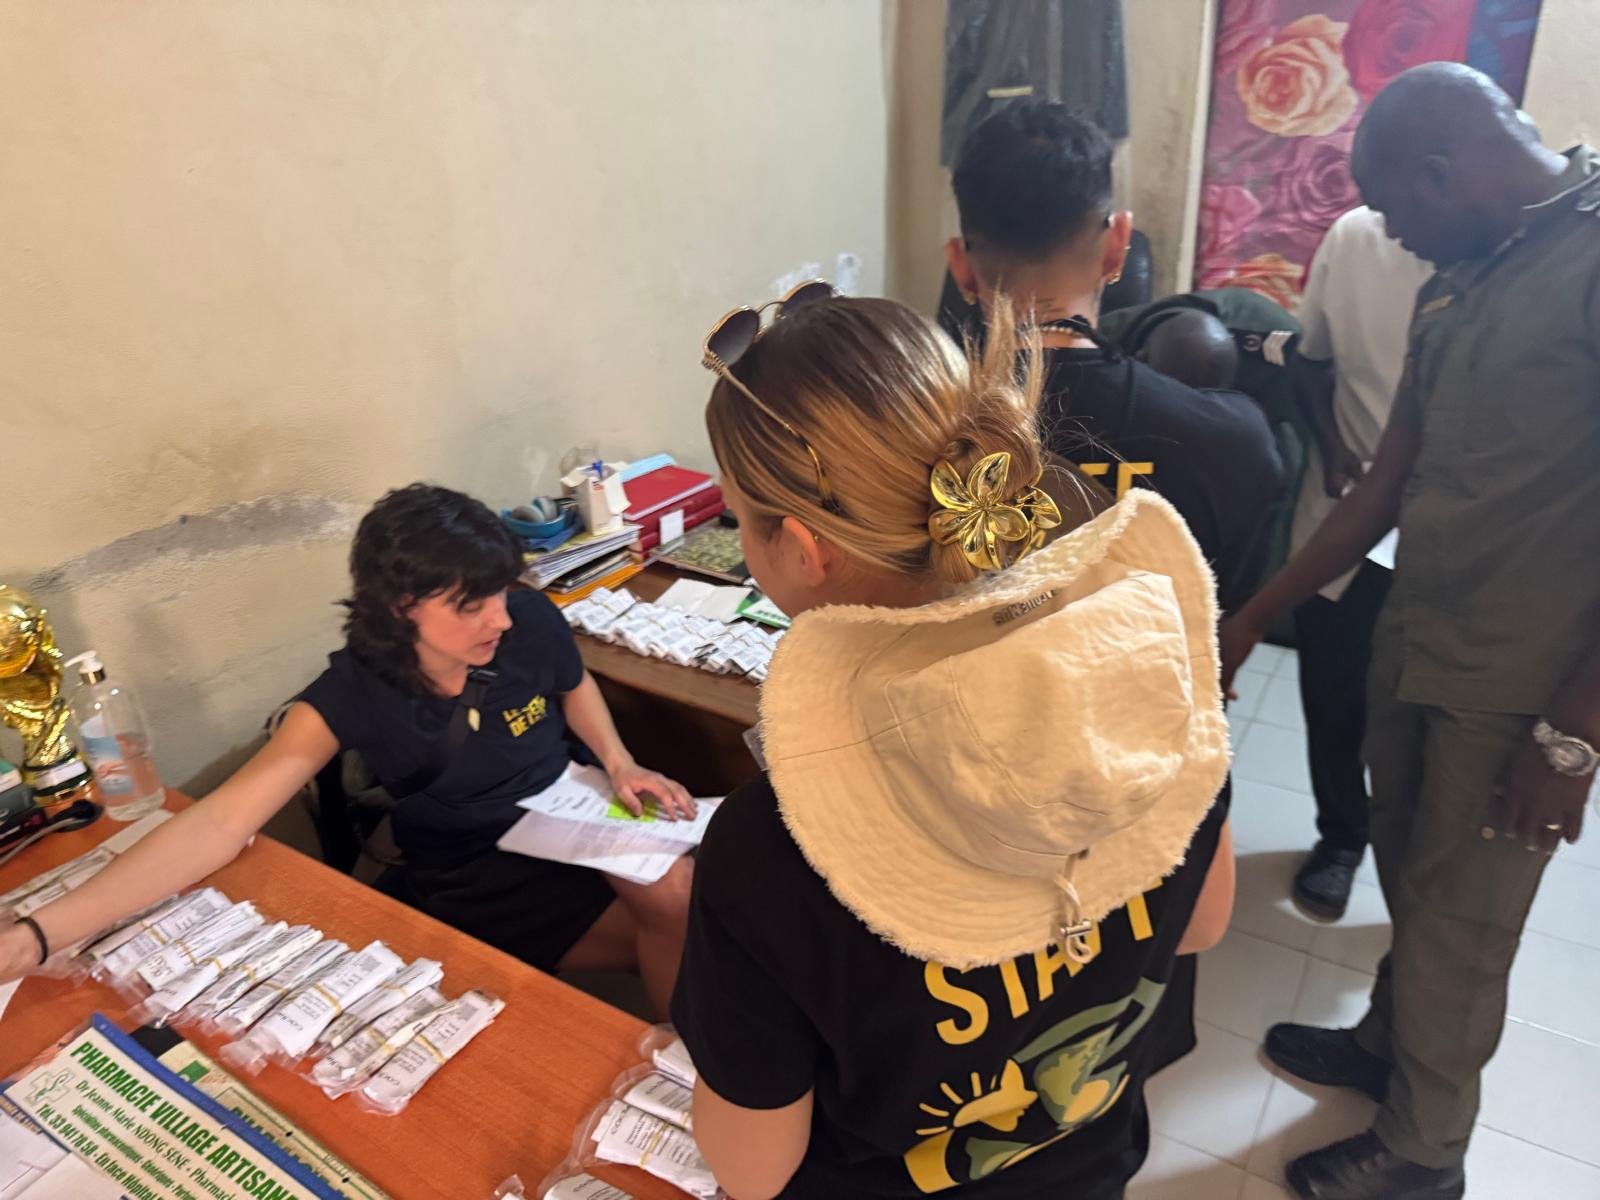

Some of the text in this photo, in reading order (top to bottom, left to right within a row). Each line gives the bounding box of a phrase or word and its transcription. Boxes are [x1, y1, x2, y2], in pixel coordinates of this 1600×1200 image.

[48, 1114, 67, 1129] 33
[59, 1123, 80, 1140] 941
[70, 1041, 162, 1113] PHARMACIE
[149, 1101, 219, 1156] VILLAGE
[205, 1144, 299, 1200] ARTISAN
[75, 1080, 89, 1094] Dr
[86, 1085, 114, 1112] Jeanne
[112, 1107, 135, 1130] Marie
